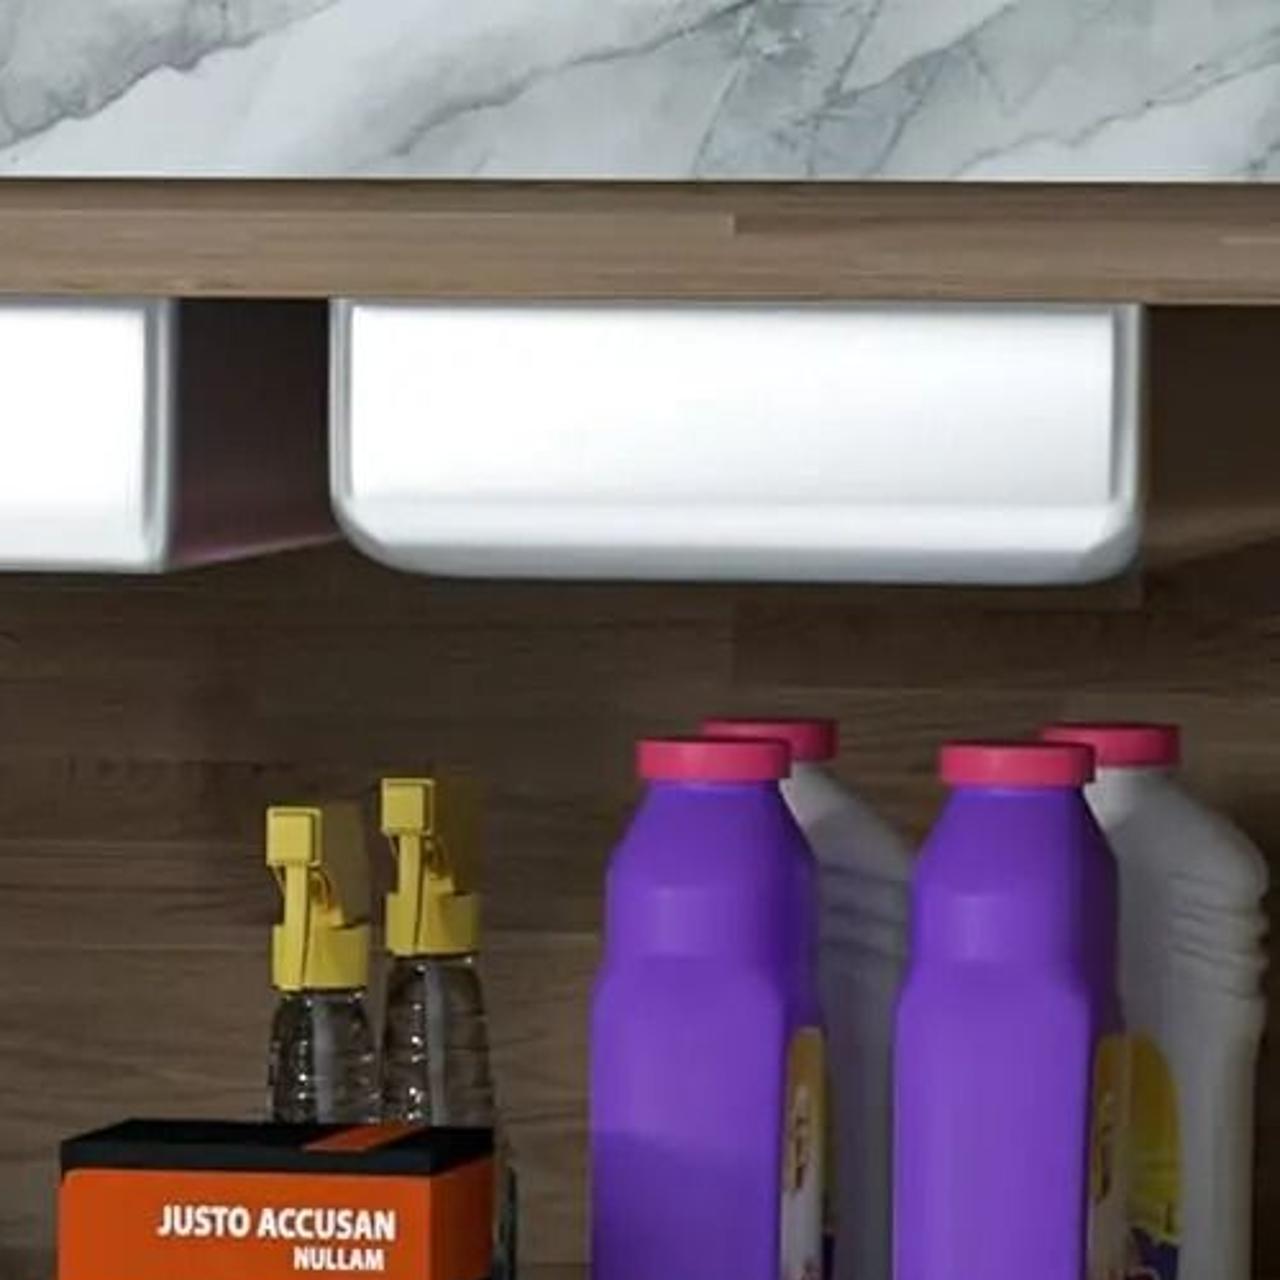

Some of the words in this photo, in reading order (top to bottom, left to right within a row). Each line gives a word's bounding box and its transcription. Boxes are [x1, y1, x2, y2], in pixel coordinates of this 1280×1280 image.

[157, 1204, 252, 1237] JUSTO
[257, 1207, 397, 1241] ACCUSAN
[293, 1246, 385, 1271] NULLAM
